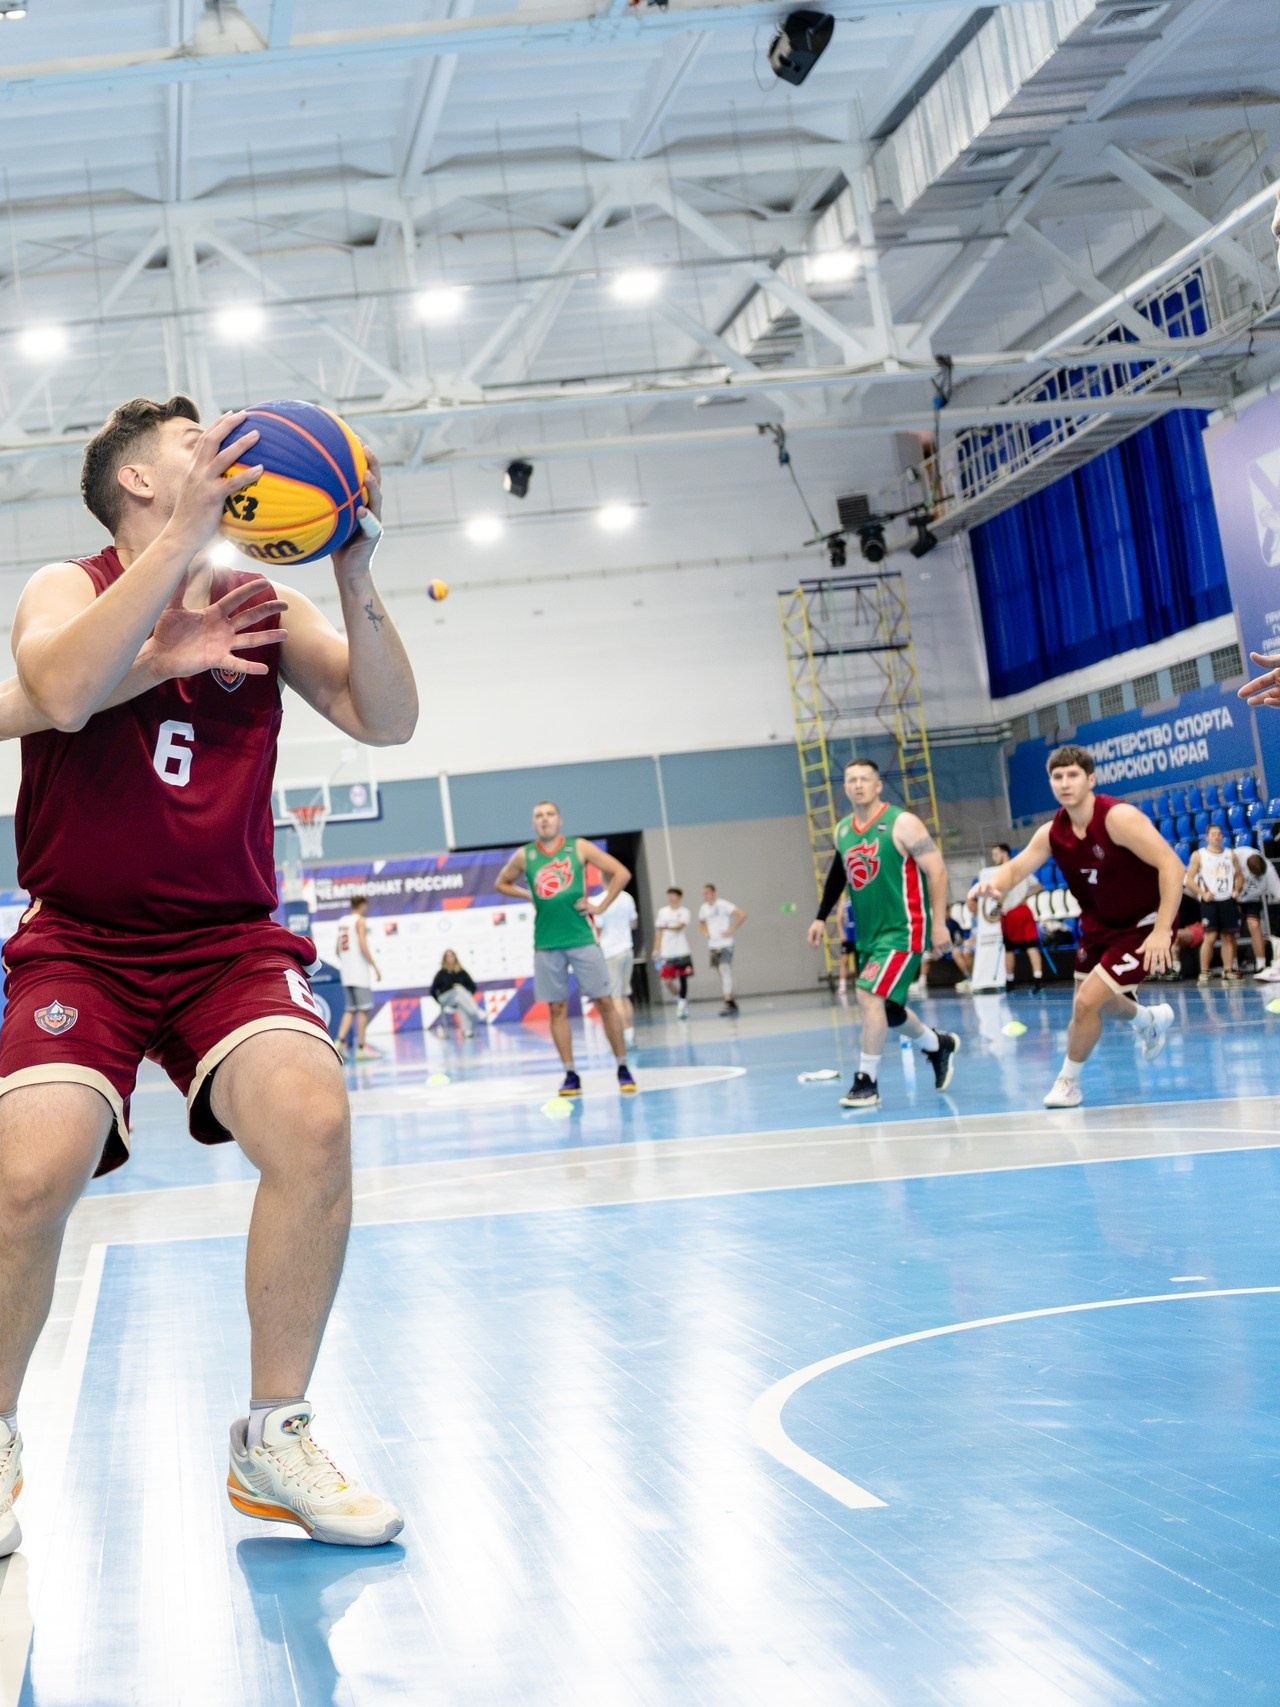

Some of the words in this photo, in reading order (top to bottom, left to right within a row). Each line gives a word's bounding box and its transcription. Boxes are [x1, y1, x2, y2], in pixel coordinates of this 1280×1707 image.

[153, 719, 195, 787] 6
[1086, 722, 1172, 763] НИСТЕРСТВО
[1174, 706, 1234, 741] СПОРТА
[1095, 749, 1168, 786] МОРСКОГО
[1170, 738, 1209, 769] КРАЯ
[315, 879, 402, 900] ЧЕМПИОНАТ
[404, 873, 464, 893] РОССИИ
[1080, 868, 1098, 885] 7
[1112, 952, 1140, 977] 7
